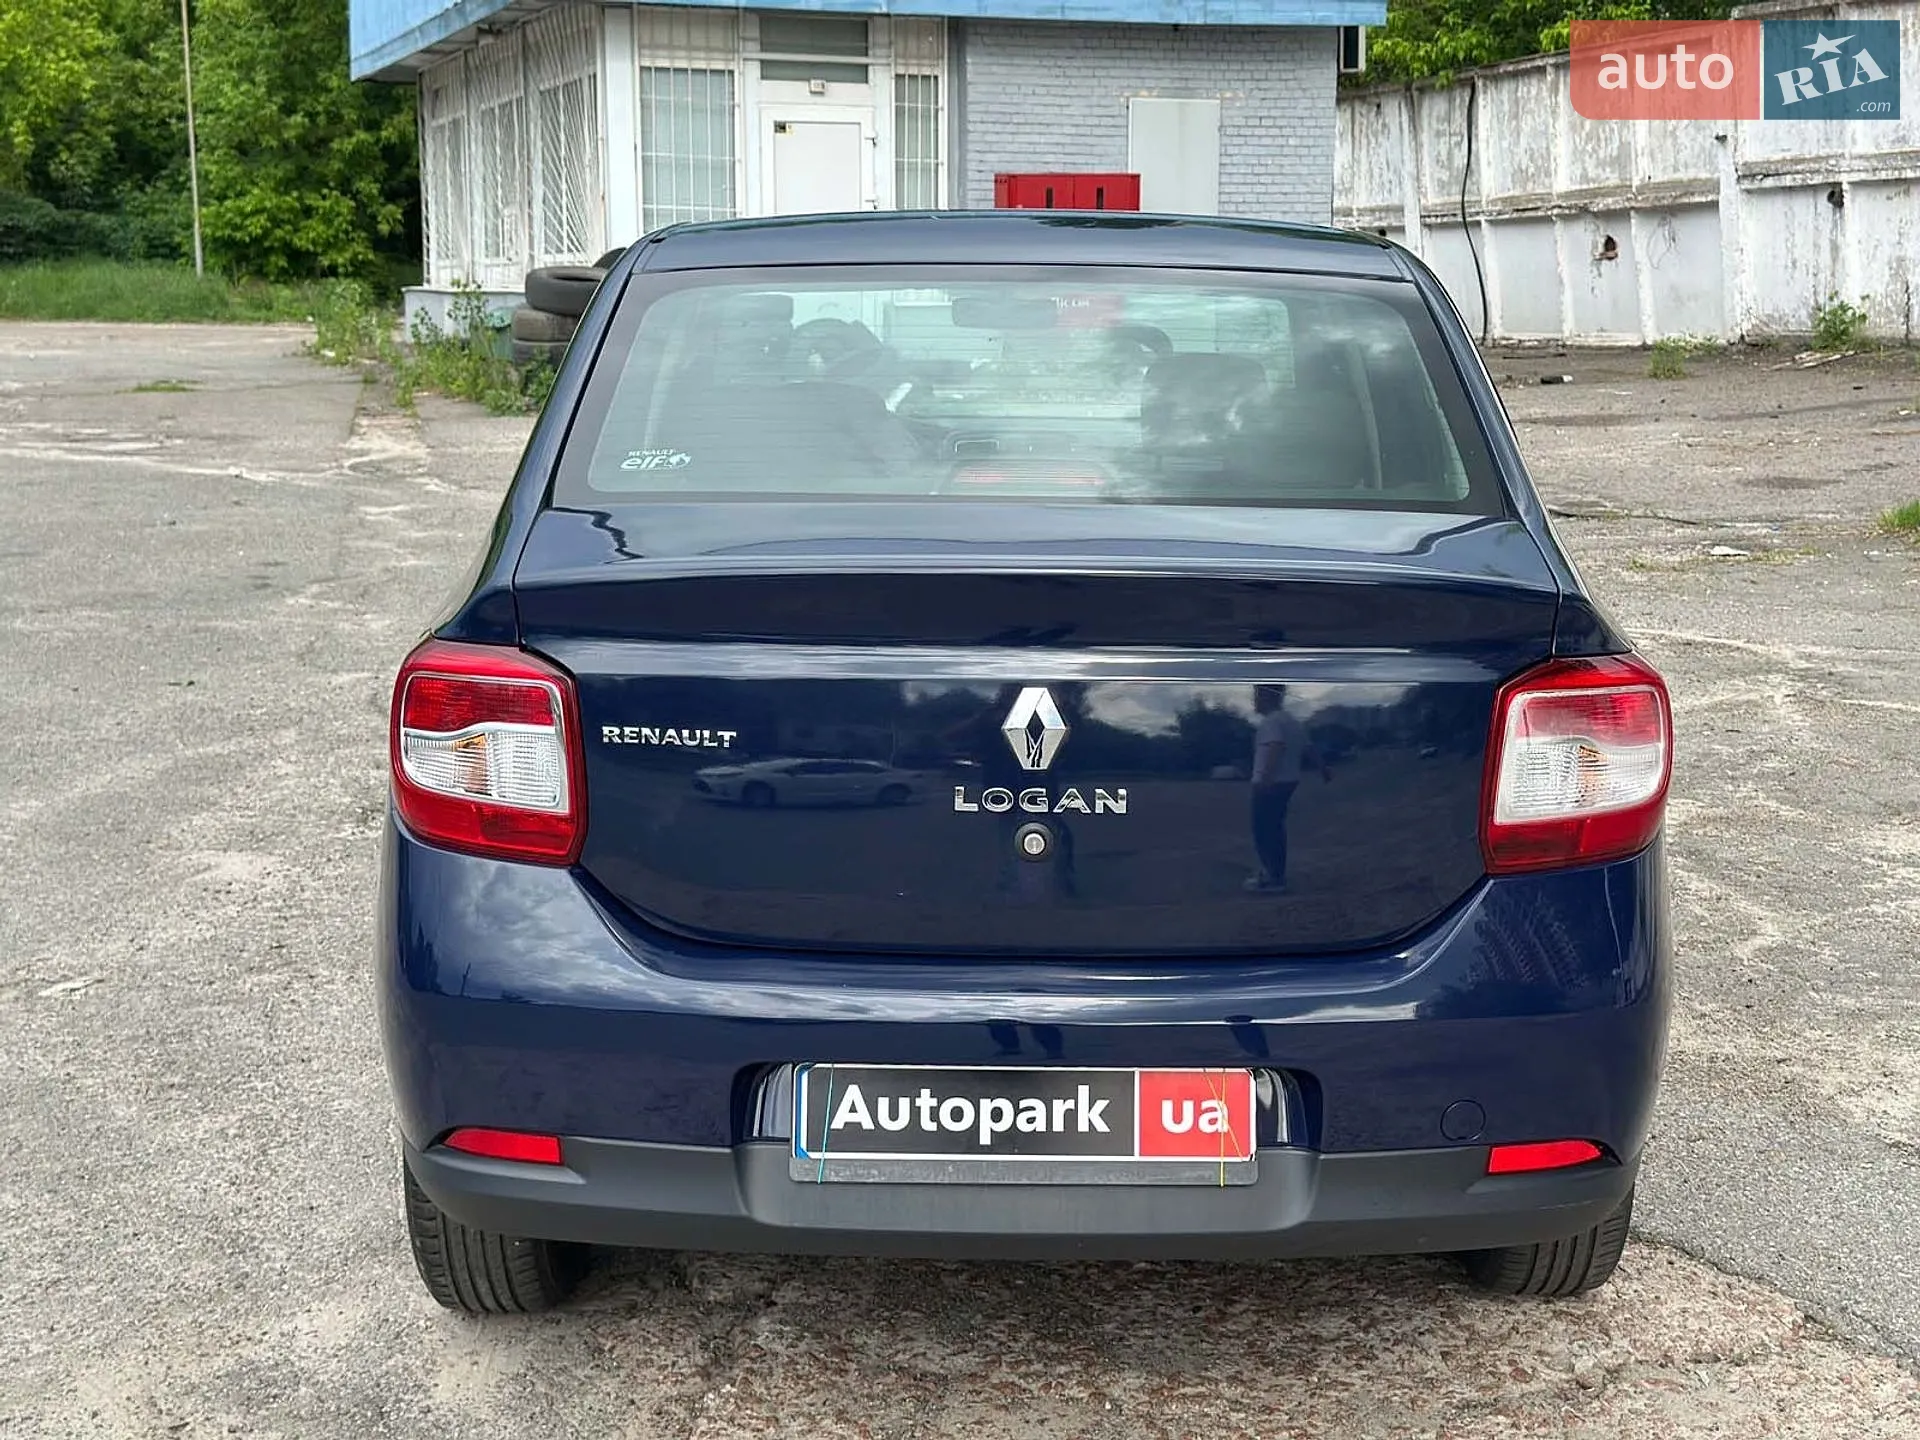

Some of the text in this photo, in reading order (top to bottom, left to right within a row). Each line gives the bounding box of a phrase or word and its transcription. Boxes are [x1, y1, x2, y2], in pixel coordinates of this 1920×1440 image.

[601, 725, 738, 749] RENAULT
[953, 786, 1128, 815] LOGAN
[829, 1084, 1230, 1145] Autopark ua
